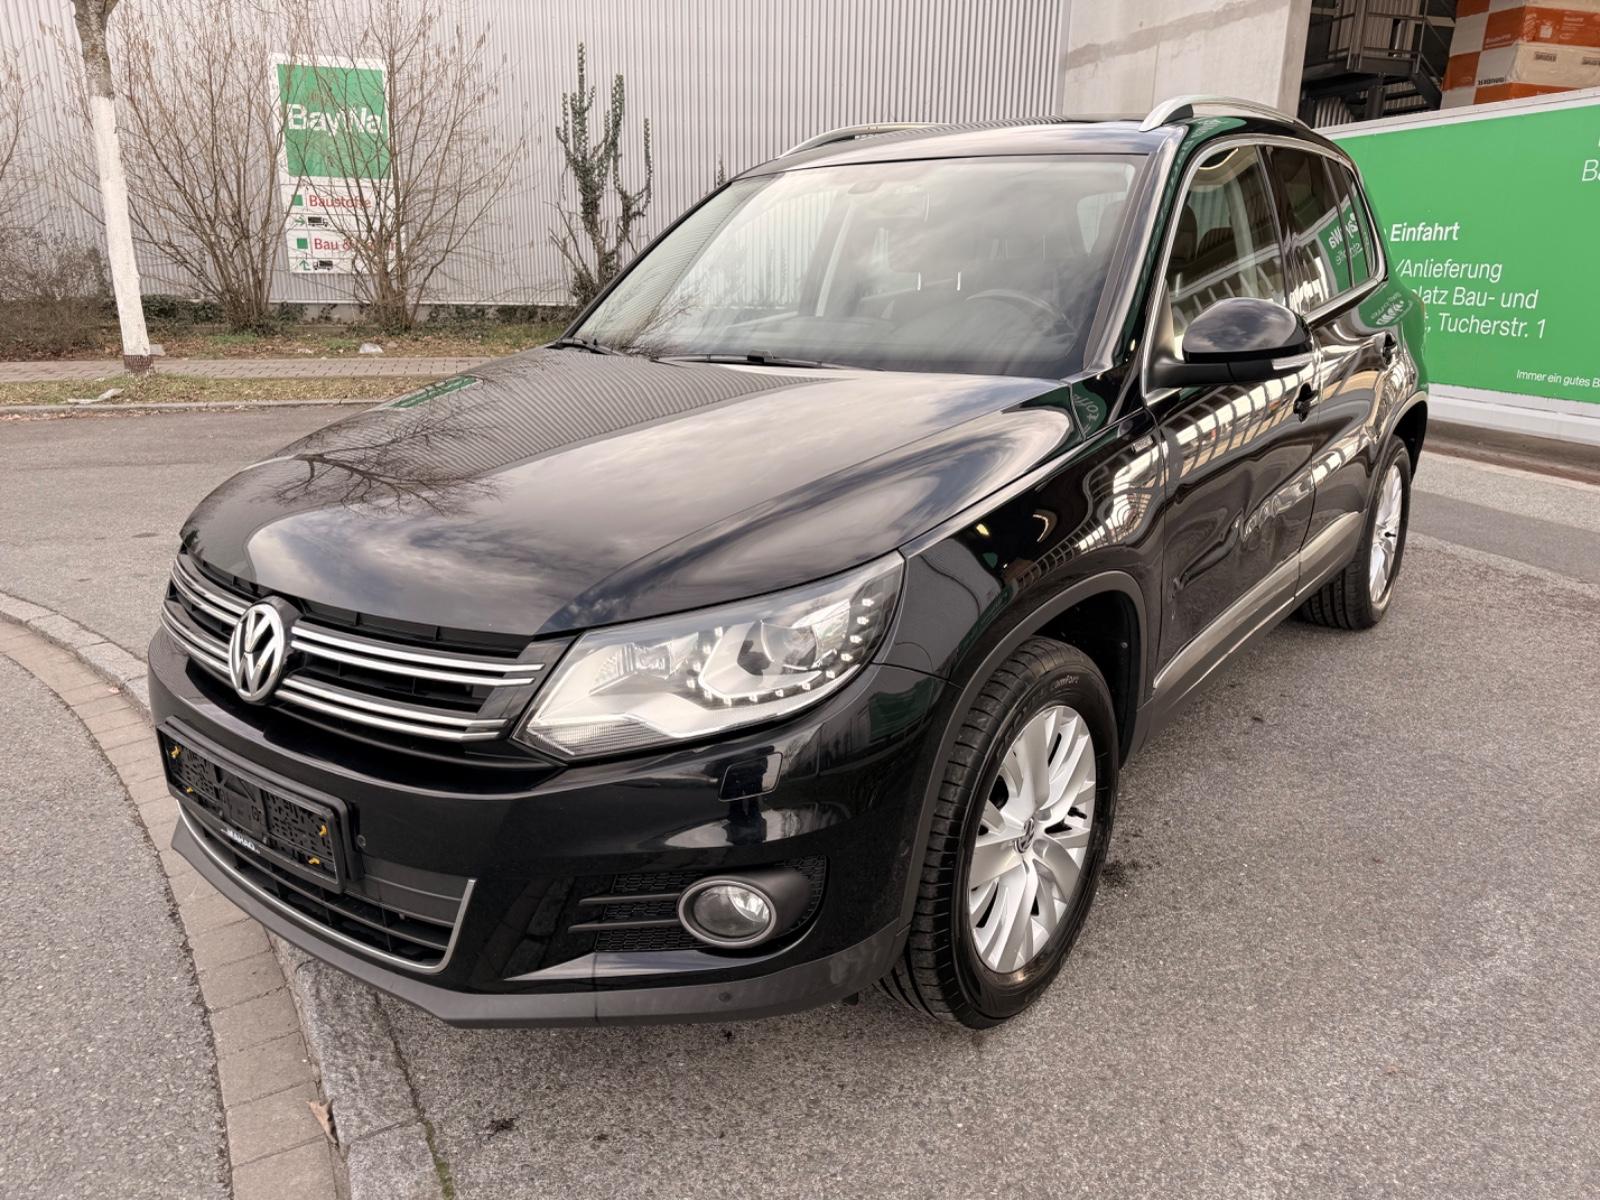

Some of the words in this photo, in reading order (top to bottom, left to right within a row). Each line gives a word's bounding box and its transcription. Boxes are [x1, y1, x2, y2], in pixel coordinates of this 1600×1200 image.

[1582, 159, 1600, 182] B
[1390, 222, 1460, 242] Einfahrt
[314, 238, 338, 250] Bau
[1411, 285, 1449, 305] latz
[1452, 286, 1496, 307] Bau-
[1500, 289, 1540, 310] und
[1438, 312, 1530, 338] Tucherstr.
[1537, 318, 1547, 339] 1
[1516, 369, 1547, 382] Immer
[1547, 372, 1562, 383] ein
[1563, 376, 1590, 387] gutes
